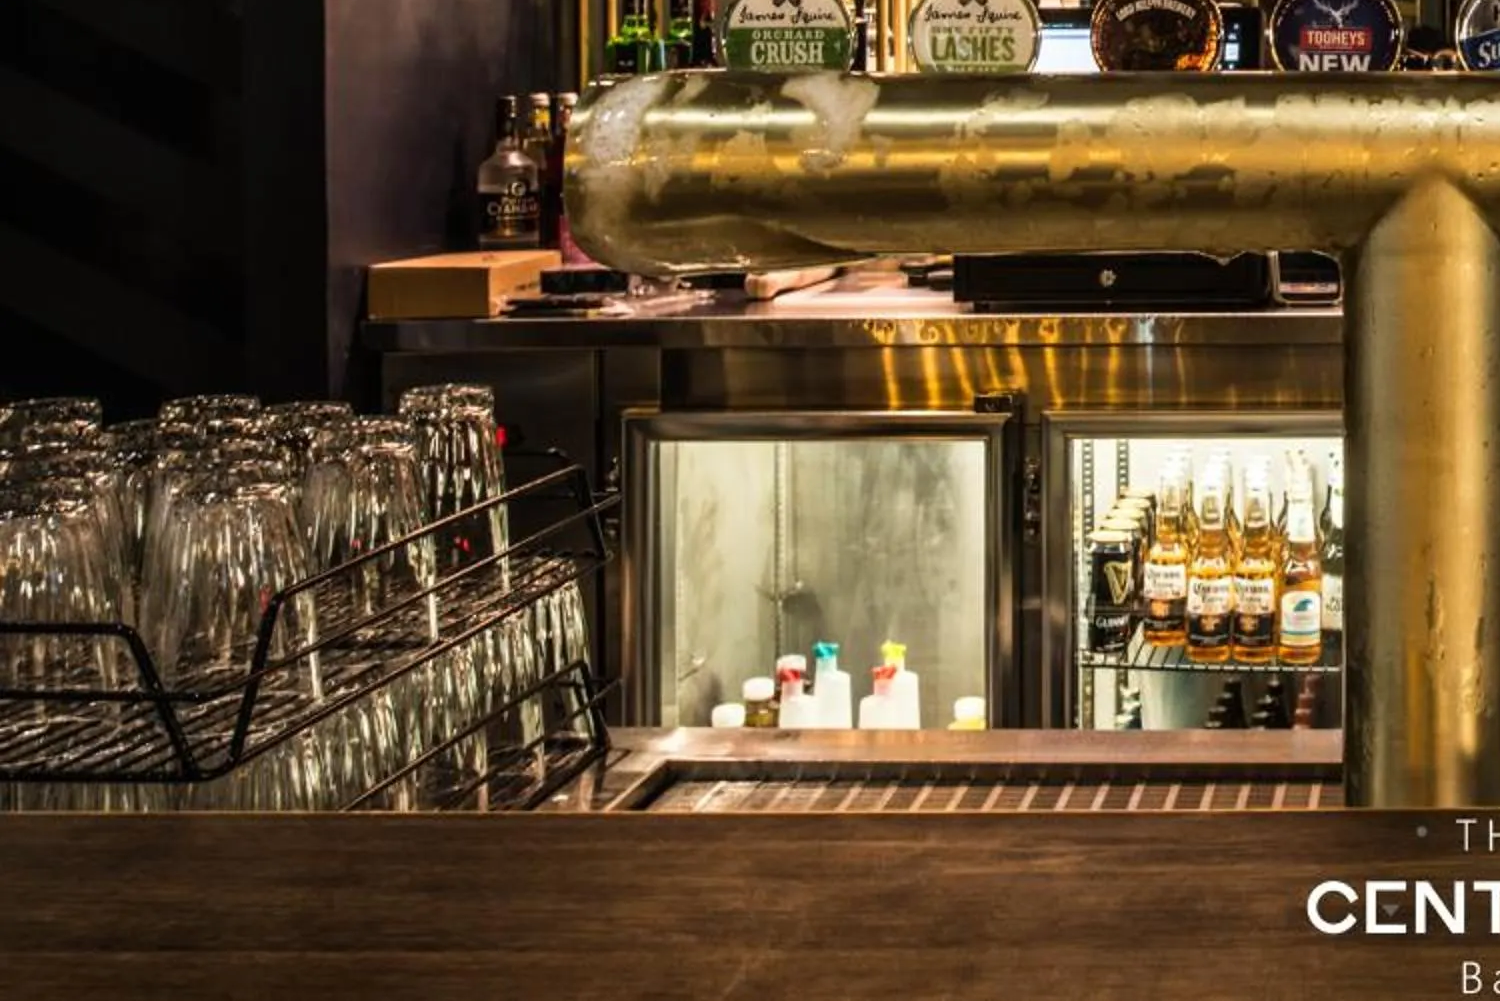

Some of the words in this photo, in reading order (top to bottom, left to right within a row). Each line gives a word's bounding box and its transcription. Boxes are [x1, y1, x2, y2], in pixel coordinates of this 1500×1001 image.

[751, 29, 825, 40] ORCHARD
[1307, 30, 1365, 47] TOOHEYS
[751, 41, 825, 65] CRUSH
[931, 35, 1016, 62] LASHES
[1299, 54, 1371, 72] NEW
